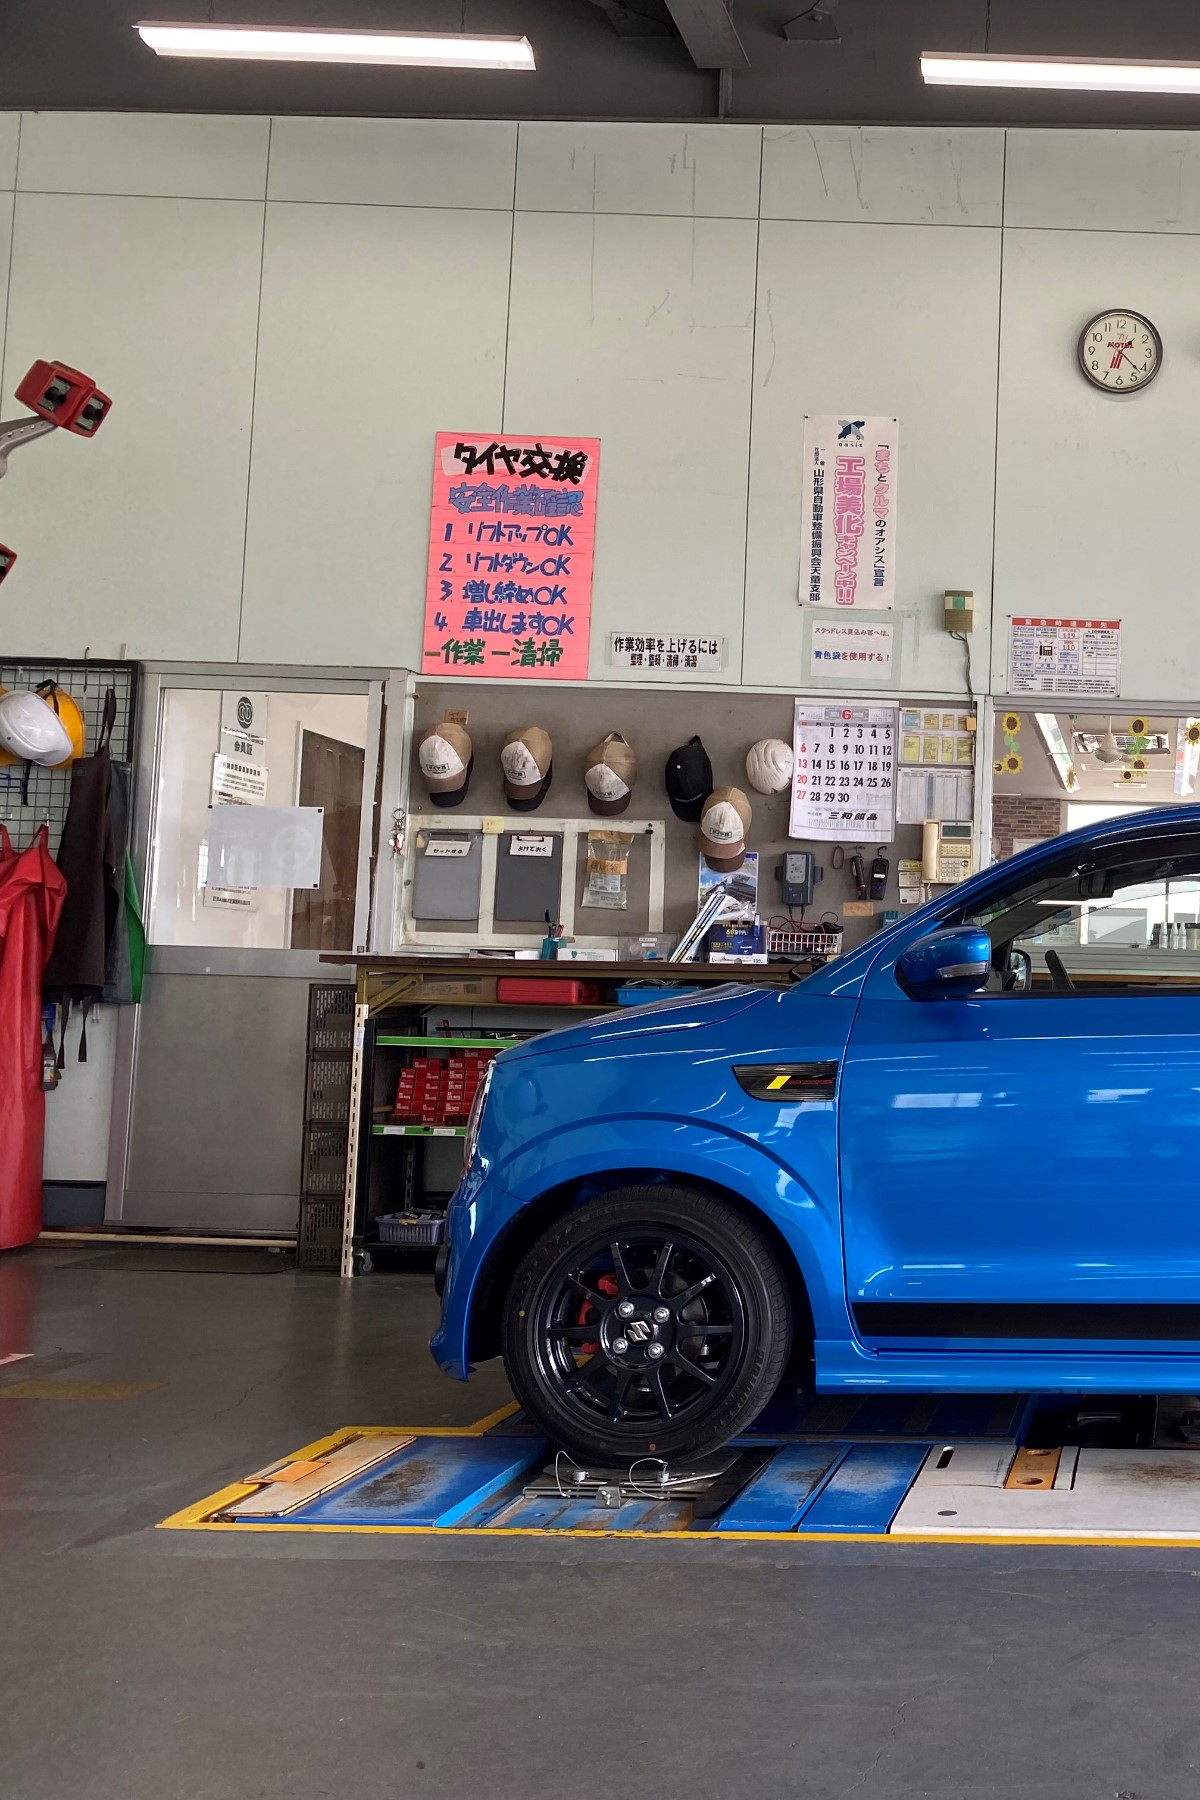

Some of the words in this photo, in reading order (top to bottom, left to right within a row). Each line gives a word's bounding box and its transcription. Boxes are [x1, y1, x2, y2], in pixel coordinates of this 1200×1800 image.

[1104, 322, 1111, 332] 11
[1116, 319, 1127, 329] 12
[1092, 332, 1103, 342] 10
[1141, 334, 1149, 344] 2
[1088, 346, 1096, 355] 9
[1145, 348, 1152, 358] 3
[1091, 360, 1099, 370] 8
[1140, 362, 1147, 371] 4
[1102, 371, 1109, 380] 7
[1115, 376, 1123, 385] 6
[1130, 372, 1137, 382] 5
[454, 441, 588, 485] タイヤ交換
[449, 482, 584, 517] 安全作業確認
[468, 521, 574, 547] リフトアップOK
[466, 552, 571, 577] リフトダウンOK
[462, 580, 568, 606] 増し締めOK
[462, 607, 575, 636] 車出しますOK
[614, 636, 718, 655] 作業効率を上げるには
[841, 709, 852, 720] 6
[843, 728, 849, 738] 2
[857, 729, 863, 738] 3
[871, 729, 877, 739] 4
[885, 729, 890, 739] 5
[234, 740, 253, 755] 会員証
[800, 743, 807, 753] 6
[814, 743, 820, 753] 7
[828, 744, 835, 753] 8
[842, 744, 849, 754] 9
[854, 745, 865, 754] 10
[869, 745, 878, 755] 11
[882, 745, 892, 755] 12
[797, 759, 808, 769] 13
[811, 759, 822, 769] 14
[826, 760, 836, 770] 15
[840, 760, 850, 770] 16
[854, 761, 864, 770] 17
[868, 761, 878, 771] 18
[881, 761, 891, 772] 19
[796, 775, 808, 785] 20
[811, 776, 821, 786] 21
[825, 776, 836, 786] 22
[839, 777, 850, 787] 23
[853, 777, 864, 787] 24
[867, 778, 878, 788] 25
[880, 778, 891, 788] 26
[796, 790, 807, 800] 27
[809, 791, 821, 802] 28
[824, 792, 835, 803] 29
[837, 793, 850, 803] 30
